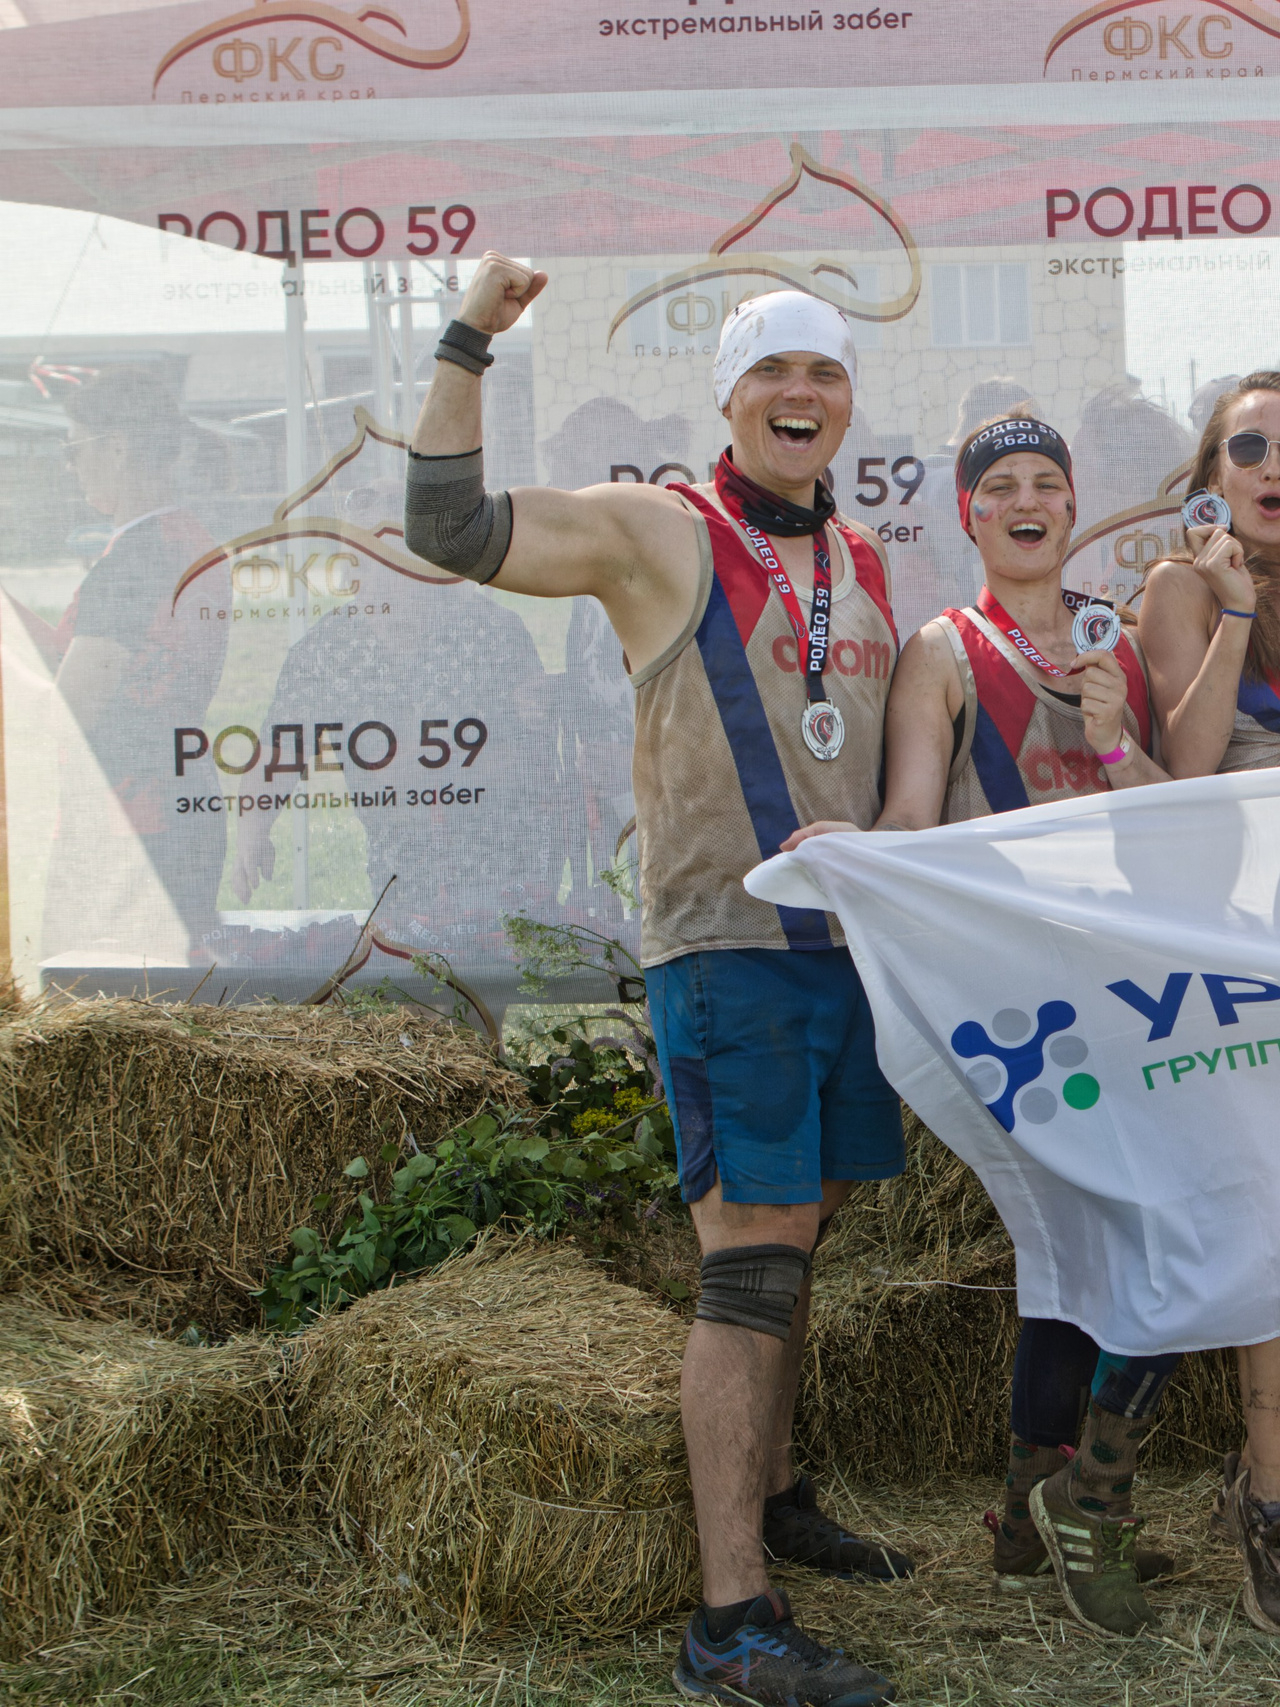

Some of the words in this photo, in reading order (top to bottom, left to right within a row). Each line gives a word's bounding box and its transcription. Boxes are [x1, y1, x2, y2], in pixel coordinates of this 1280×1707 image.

[598, 10, 823, 39] экстремальный
[833, 8, 913, 30] забег
[1103, 15, 1233, 60] ФКС
[212, 36, 345, 82] ФКС
[1071, 67, 1194, 82] Пермский
[1206, 65, 1265, 80] край
[181, 89, 305, 104] Пермский
[317, 87, 377, 102] край
[1046, 184, 1272, 241] РОДЕО
[158, 206, 385, 267] РОДЕО
[406, 204, 476, 256] 59
[1047, 249, 1271, 278] экстремальный
[970, 421, 1032, 453] РОДЕО
[992, 433, 1040, 451] 2620
[855, 456, 926, 507] 59
[231, 552, 360, 598] ФКС
[773, 573, 791, 594] 59
[200, 605, 321, 621] Пермский
[333, 602, 391, 619] край
[816, 588, 829, 608] 59
[808, 612, 829, 671] РОДЕО
[1008, 628, 1050, 670] РОДЕО
[173, 720, 397, 782] РОДЕО
[417, 718, 488, 769] 59
[176, 786, 397, 816] экстремальный
[407, 784, 485, 804] забег
